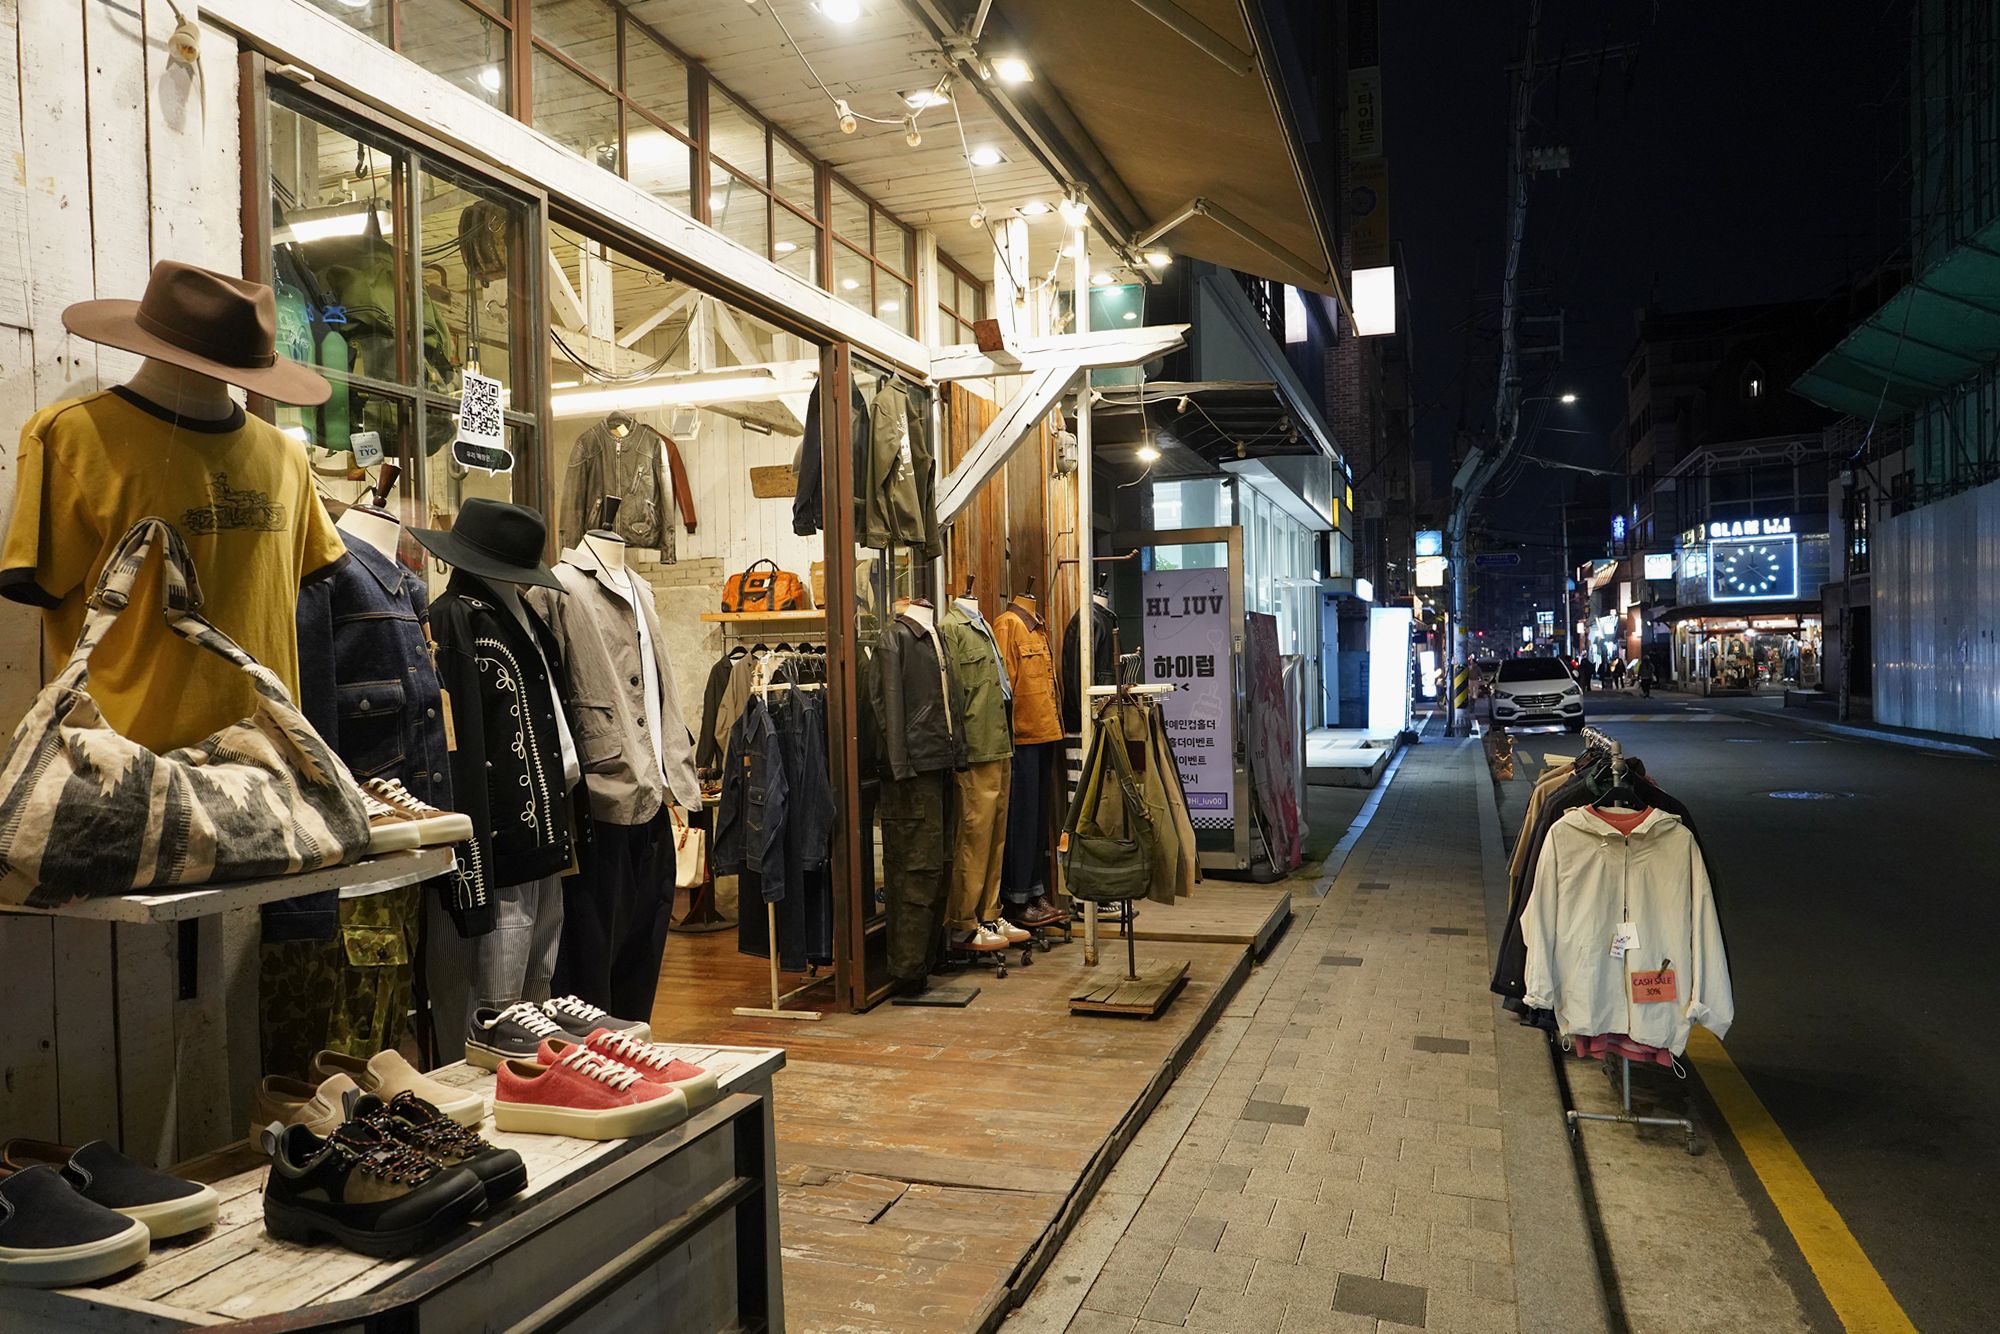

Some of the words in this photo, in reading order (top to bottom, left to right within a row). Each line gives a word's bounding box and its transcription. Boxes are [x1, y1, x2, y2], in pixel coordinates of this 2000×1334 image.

[359, 448, 378, 456] TYO
[1153, 655, 1215, 679] 하이럽
[1175, 755, 1207, 766] 이벤트
